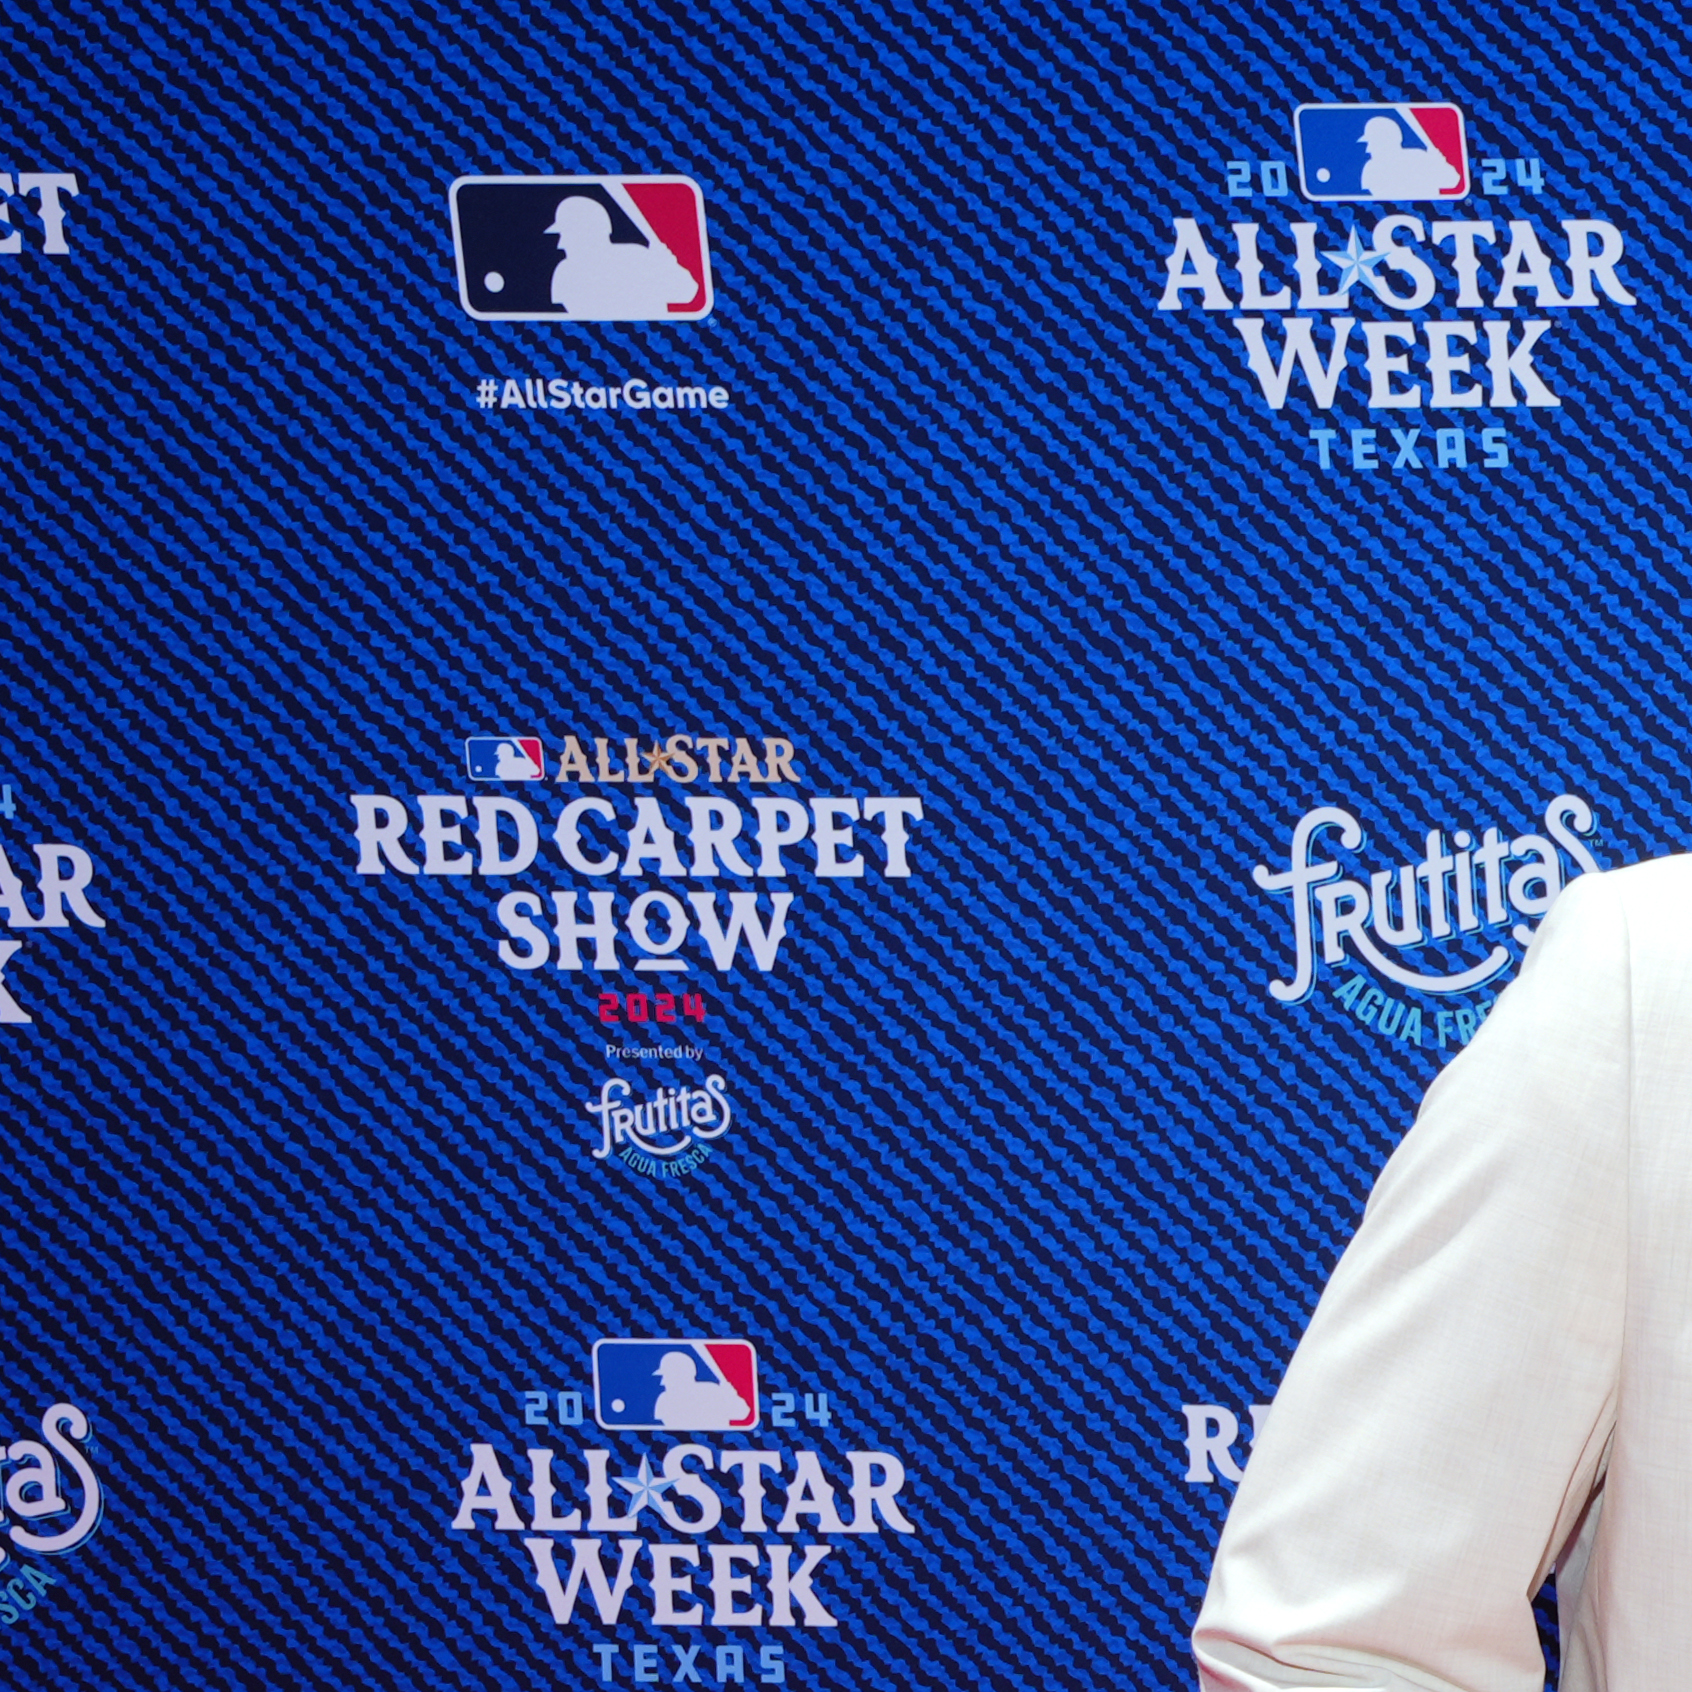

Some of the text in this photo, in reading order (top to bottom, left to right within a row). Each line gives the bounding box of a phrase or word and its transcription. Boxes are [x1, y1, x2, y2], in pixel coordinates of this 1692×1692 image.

[1227, 158, 1544, 196] 20 24
[1233, 317, 1560, 409] WEEK
[477, 379, 729, 409] #AllStarGame
[1309, 428, 1508, 469] TEXAS
[351, 795, 923, 877] RED CARPET
[497, 891, 793, 971] SHOW
[598, 993, 707, 1022] 2024
[1332, 974, 1422, 1046] AGUA
[606, 1044, 703, 1061] Presented by
[619, 1143, 713, 1178] AGUA FRESCA
[525, 1391, 831, 1426] 20 24
[524, 1538, 837, 1626] WEEK
[593, 1644, 785, 1683] TEXAS
